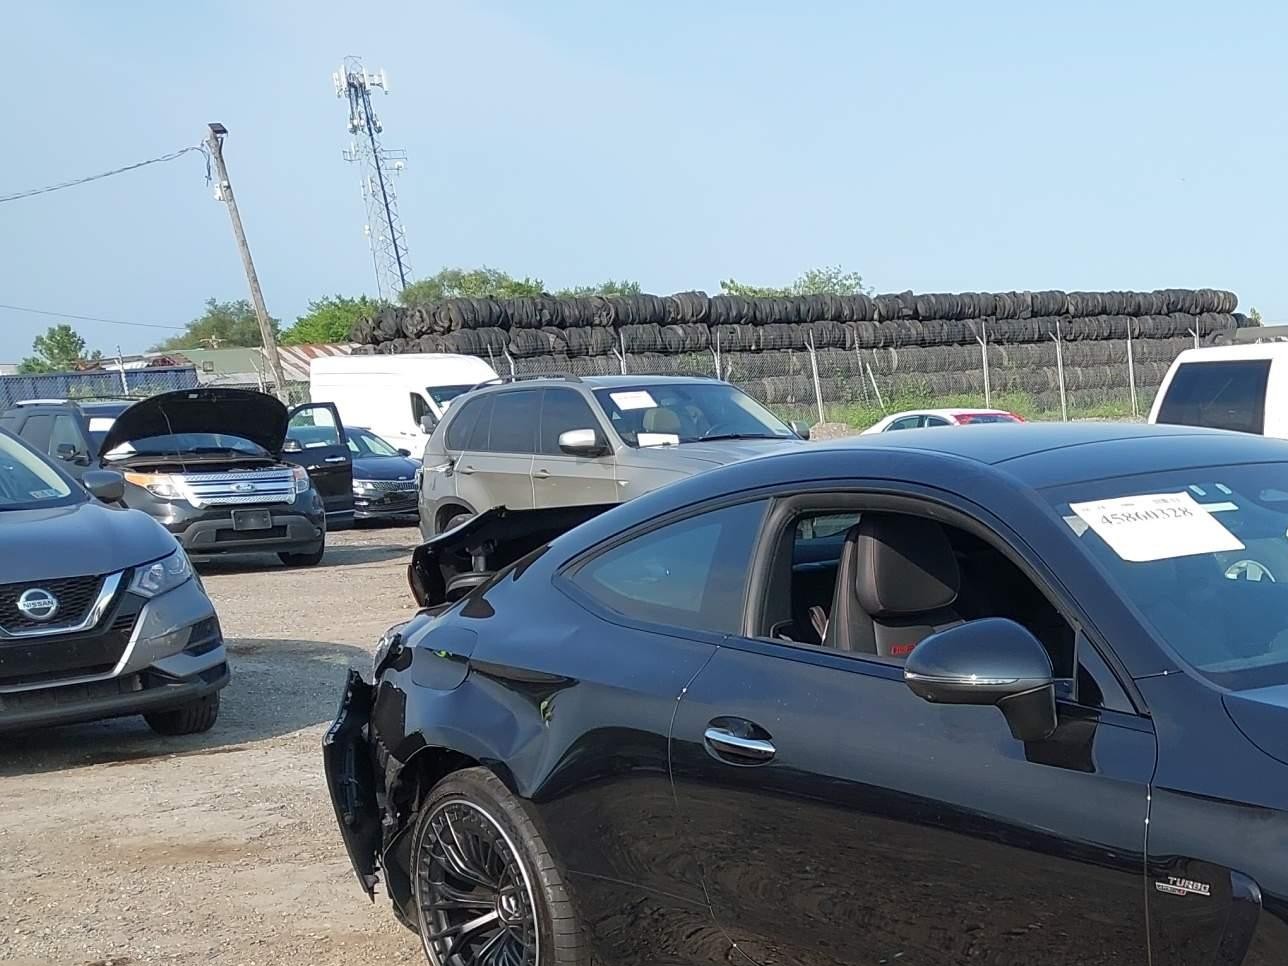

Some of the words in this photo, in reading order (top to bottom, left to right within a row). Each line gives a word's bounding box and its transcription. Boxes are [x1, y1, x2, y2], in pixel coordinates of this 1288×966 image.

[1100, 507, 1194, 525] 45860328
[22, 599, 53, 609] NISSAN
[1168, 876, 1210, 892] TURBO
